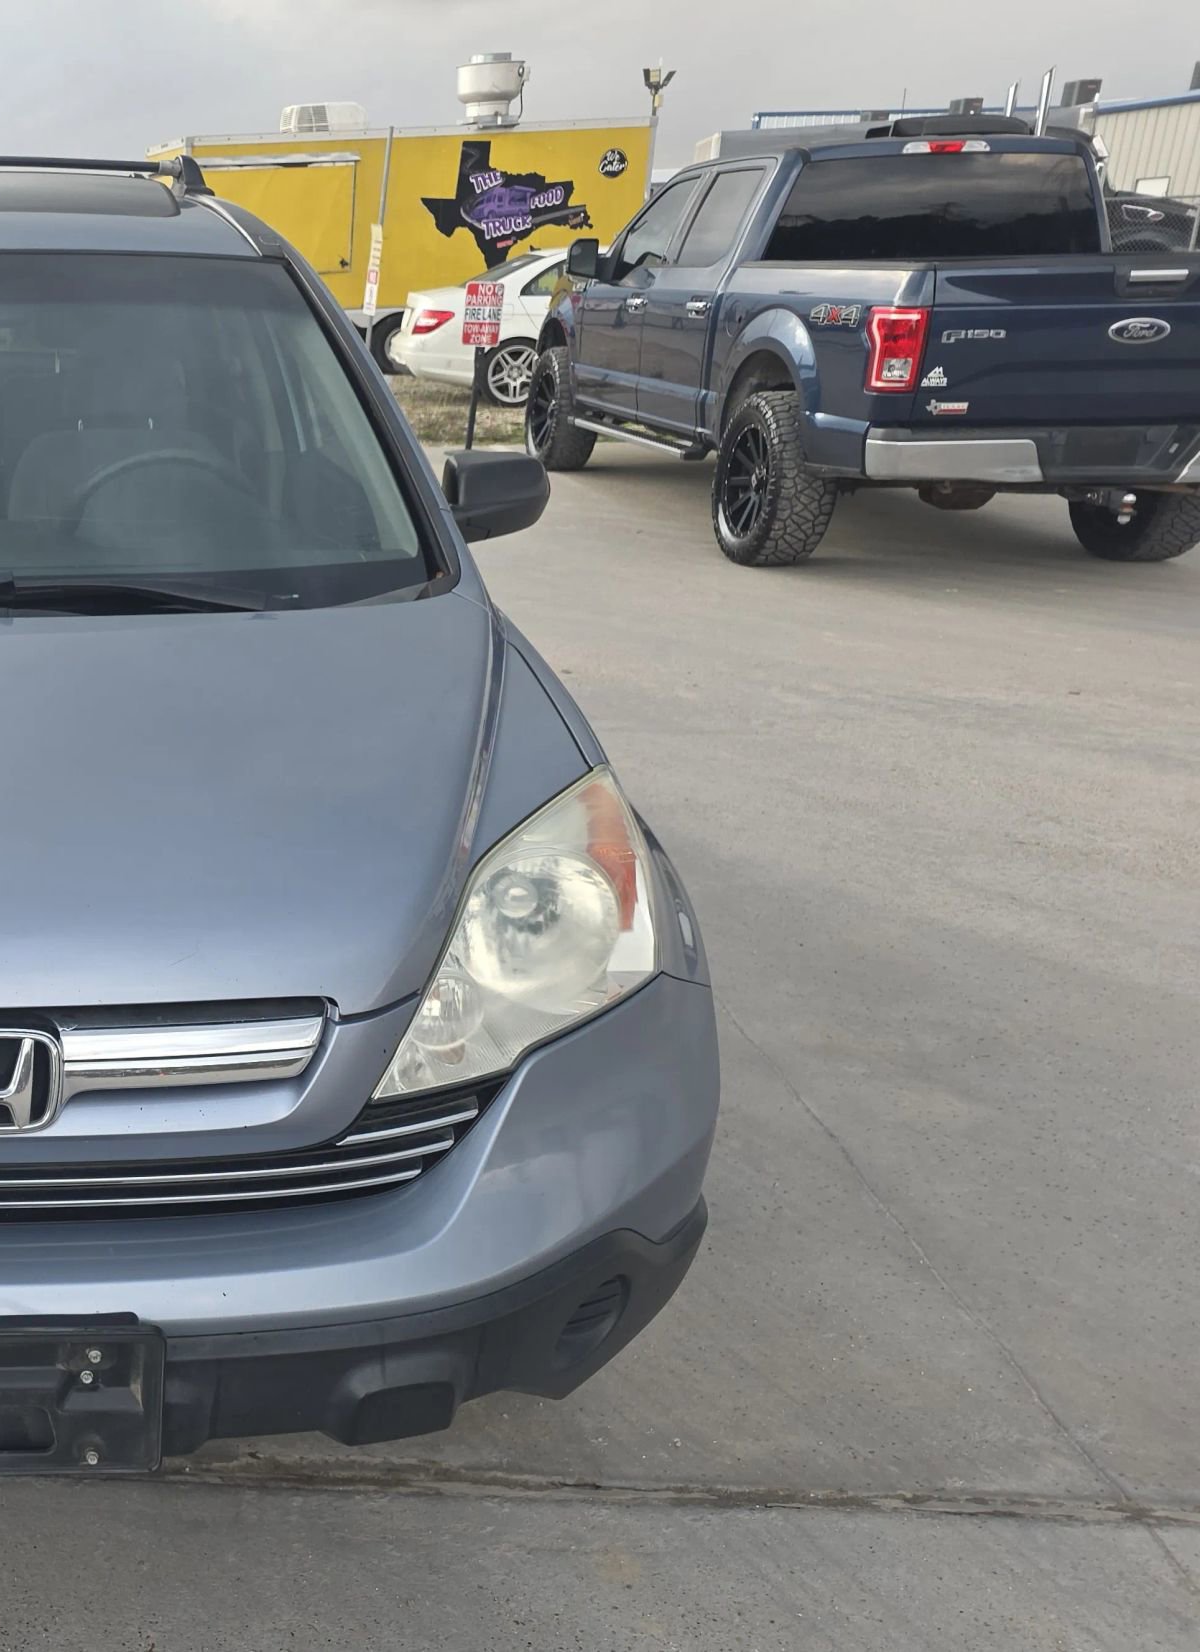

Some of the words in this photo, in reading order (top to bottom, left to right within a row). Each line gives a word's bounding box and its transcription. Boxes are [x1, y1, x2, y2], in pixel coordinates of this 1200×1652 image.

[606, 150, 620, 161] We
[469, 170, 504, 194] THE
[530, 186, 564, 209] FOOD
[481, 214, 532, 240] TRUCK
[478, 284, 495, 296] NO
[465, 295, 503, 307] PARKING
[464, 308, 481, 320] FIRE
[482, 308, 502, 320] LANE
[1123, 322, 1158, 337] Ford
[469, 333, 493, 344] ZONE
